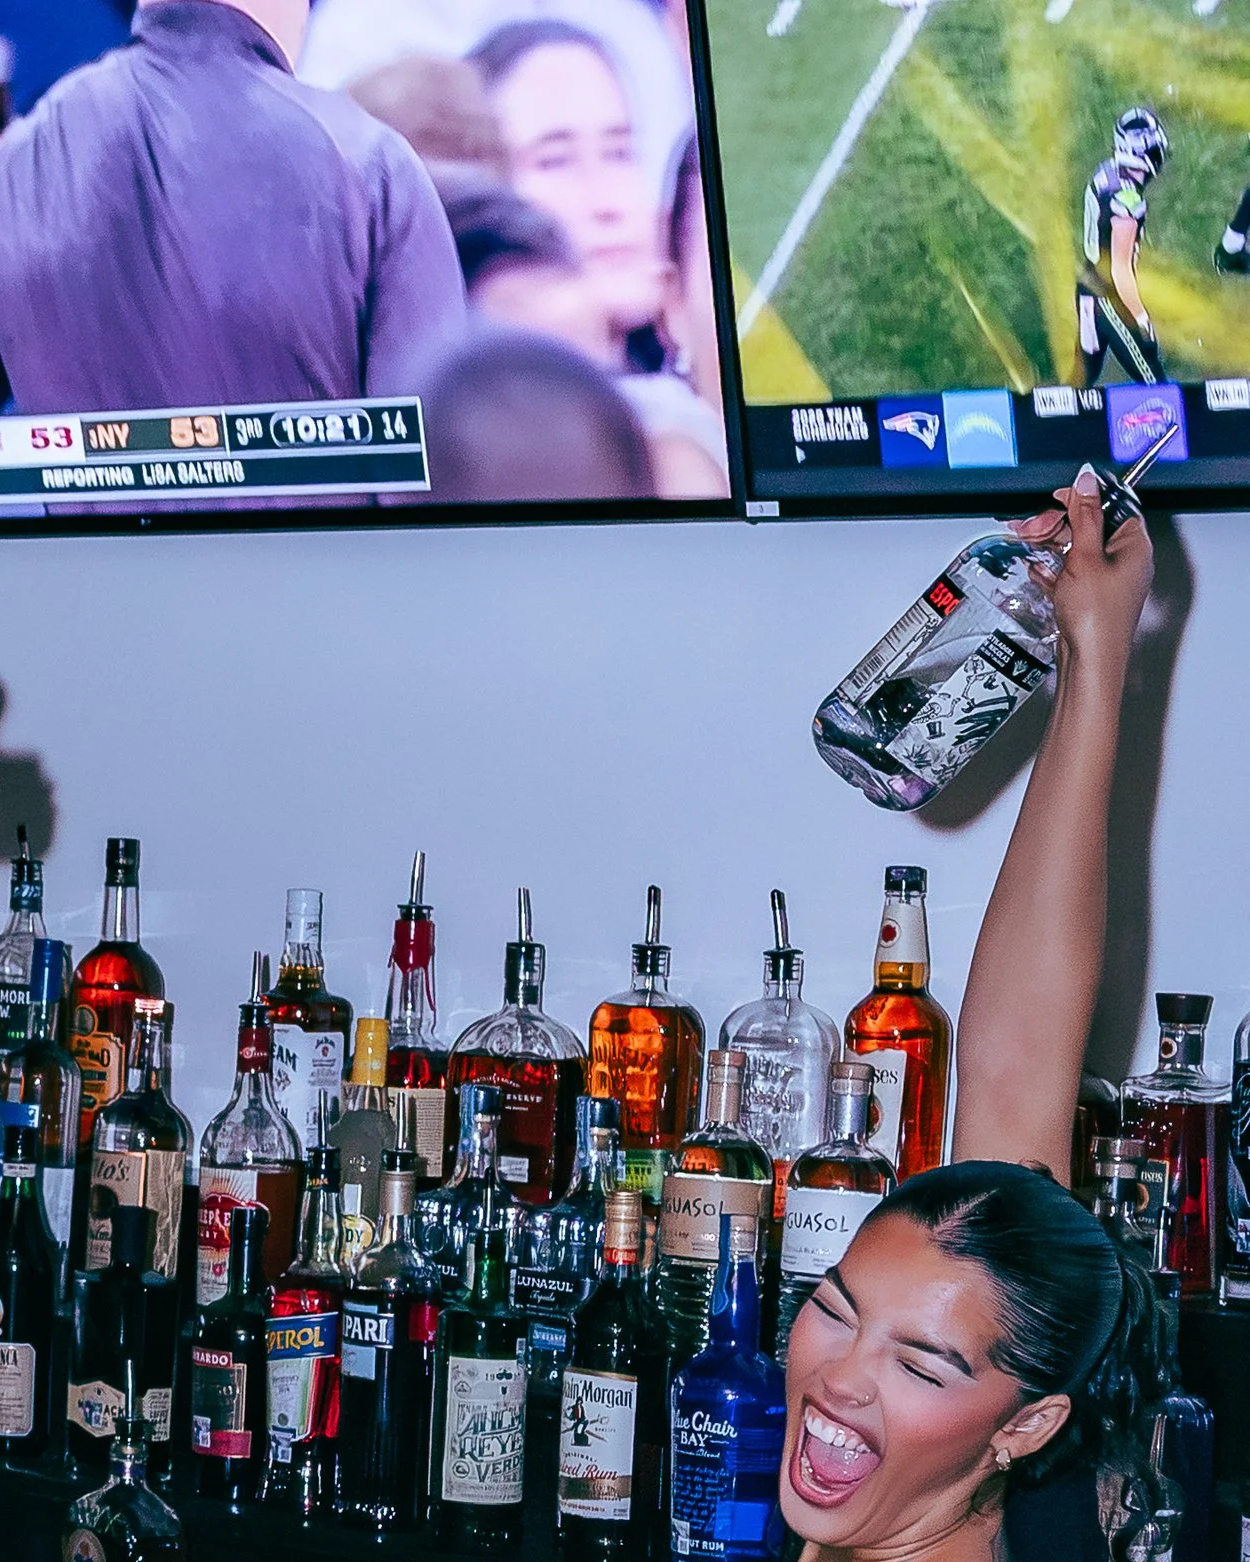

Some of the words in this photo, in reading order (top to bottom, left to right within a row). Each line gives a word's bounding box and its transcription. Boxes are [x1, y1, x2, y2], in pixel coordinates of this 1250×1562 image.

[31, 425, 75, 449] 53
[281, 413, 363, 444] 10:21
[382, 409, 408, 440] 14
[42, 465, 135, 489] REPORTING
[872, 1068, 899, 1087] ses
[345, 1228, 363, 1243] DY
[517, 1275, 574, 1293] LUNAZUL
[582, 1379, 634, 1409] Morgan
[104, 1404, 126, 1418] ACK
[457, 1411, 523, 1438] ANCH
[691, 1410, 738, 1439] Chair
[459, 1433, 523, 1462] REYE
[680, 1431, 708, 1447] BAY
[475, 1457, 521, 1483] VERD
[582, 1463, 618, 1481] Rum
[702, 1541, 725, 1552] RUM
